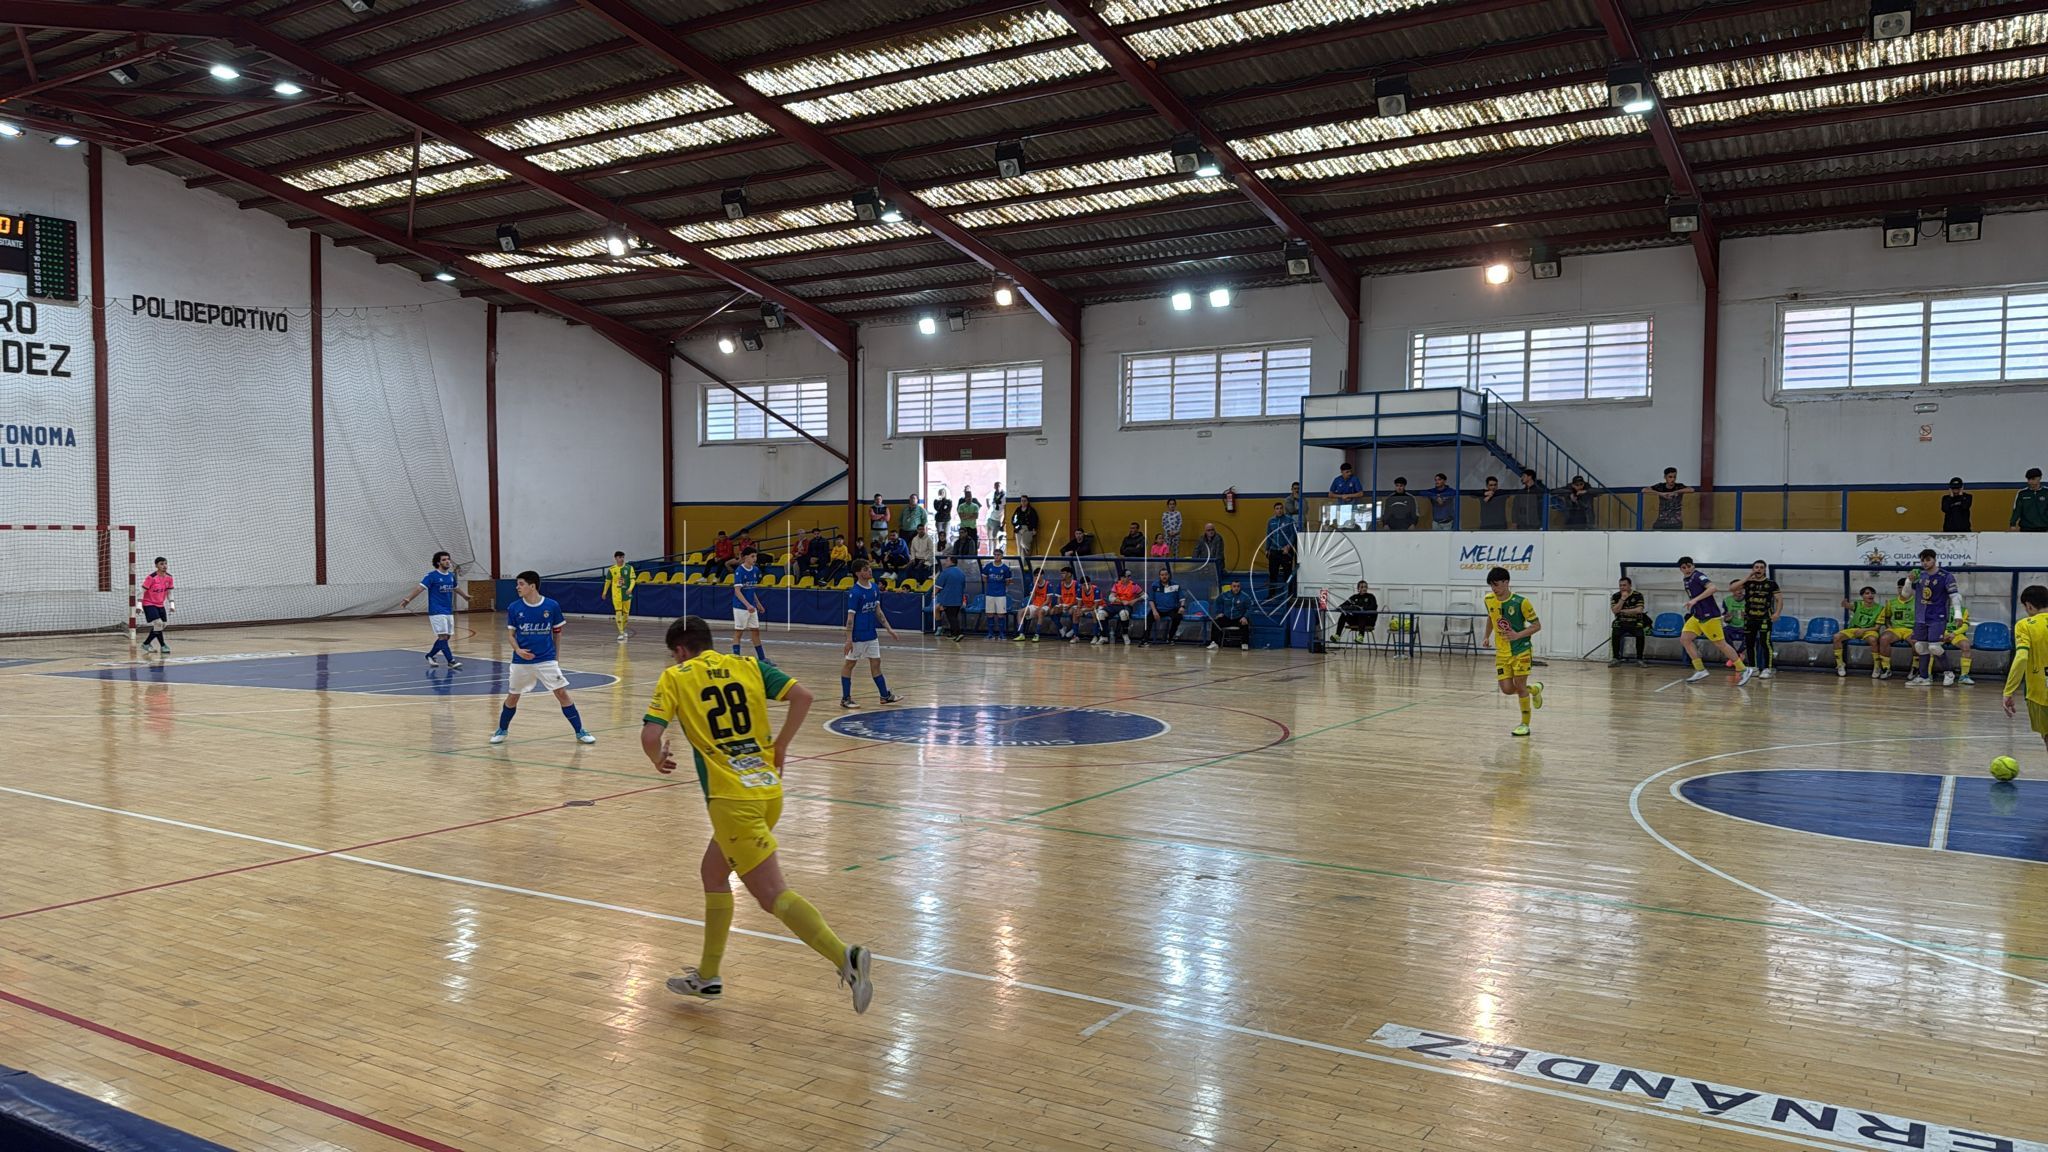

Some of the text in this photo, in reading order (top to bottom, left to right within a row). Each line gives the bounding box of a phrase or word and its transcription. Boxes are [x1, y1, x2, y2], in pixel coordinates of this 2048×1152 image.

[132, 294, 288, 333] POLIDEPORTIVO
[3, 340, 71, 377] DEZ
[1, 447, 41, 468] LLA
[1460, 544, 1534, 563] MELILLA
[1893, 552, 1920, 560] CIUDA
[701, 682, 752, 740] 28
